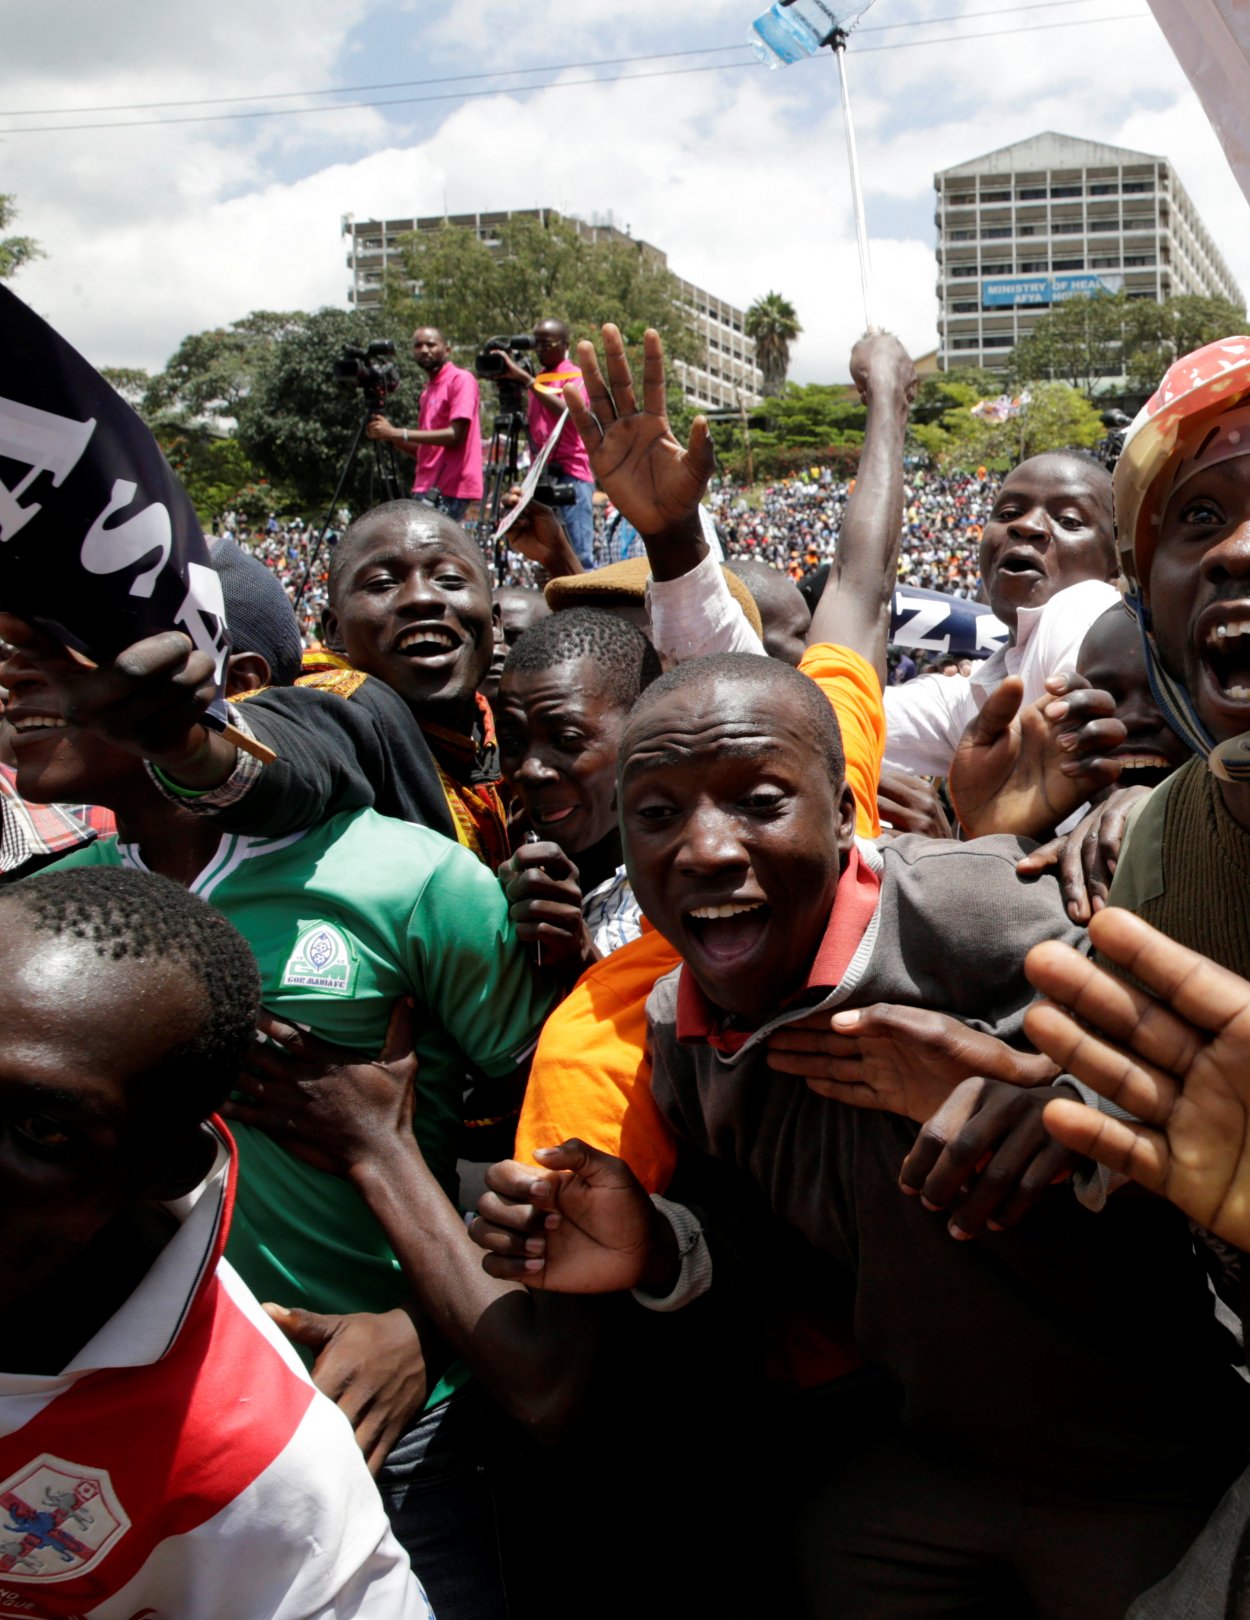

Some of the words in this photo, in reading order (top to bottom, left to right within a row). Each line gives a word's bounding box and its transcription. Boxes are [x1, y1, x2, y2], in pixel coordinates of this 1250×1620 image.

[988, 282, 1046, 295] MINISTRY
[1052, 281, 1069, 291] OF
[1014, 293, 1043, 303] AFYA
[287, 976, 306, 984] GOR
